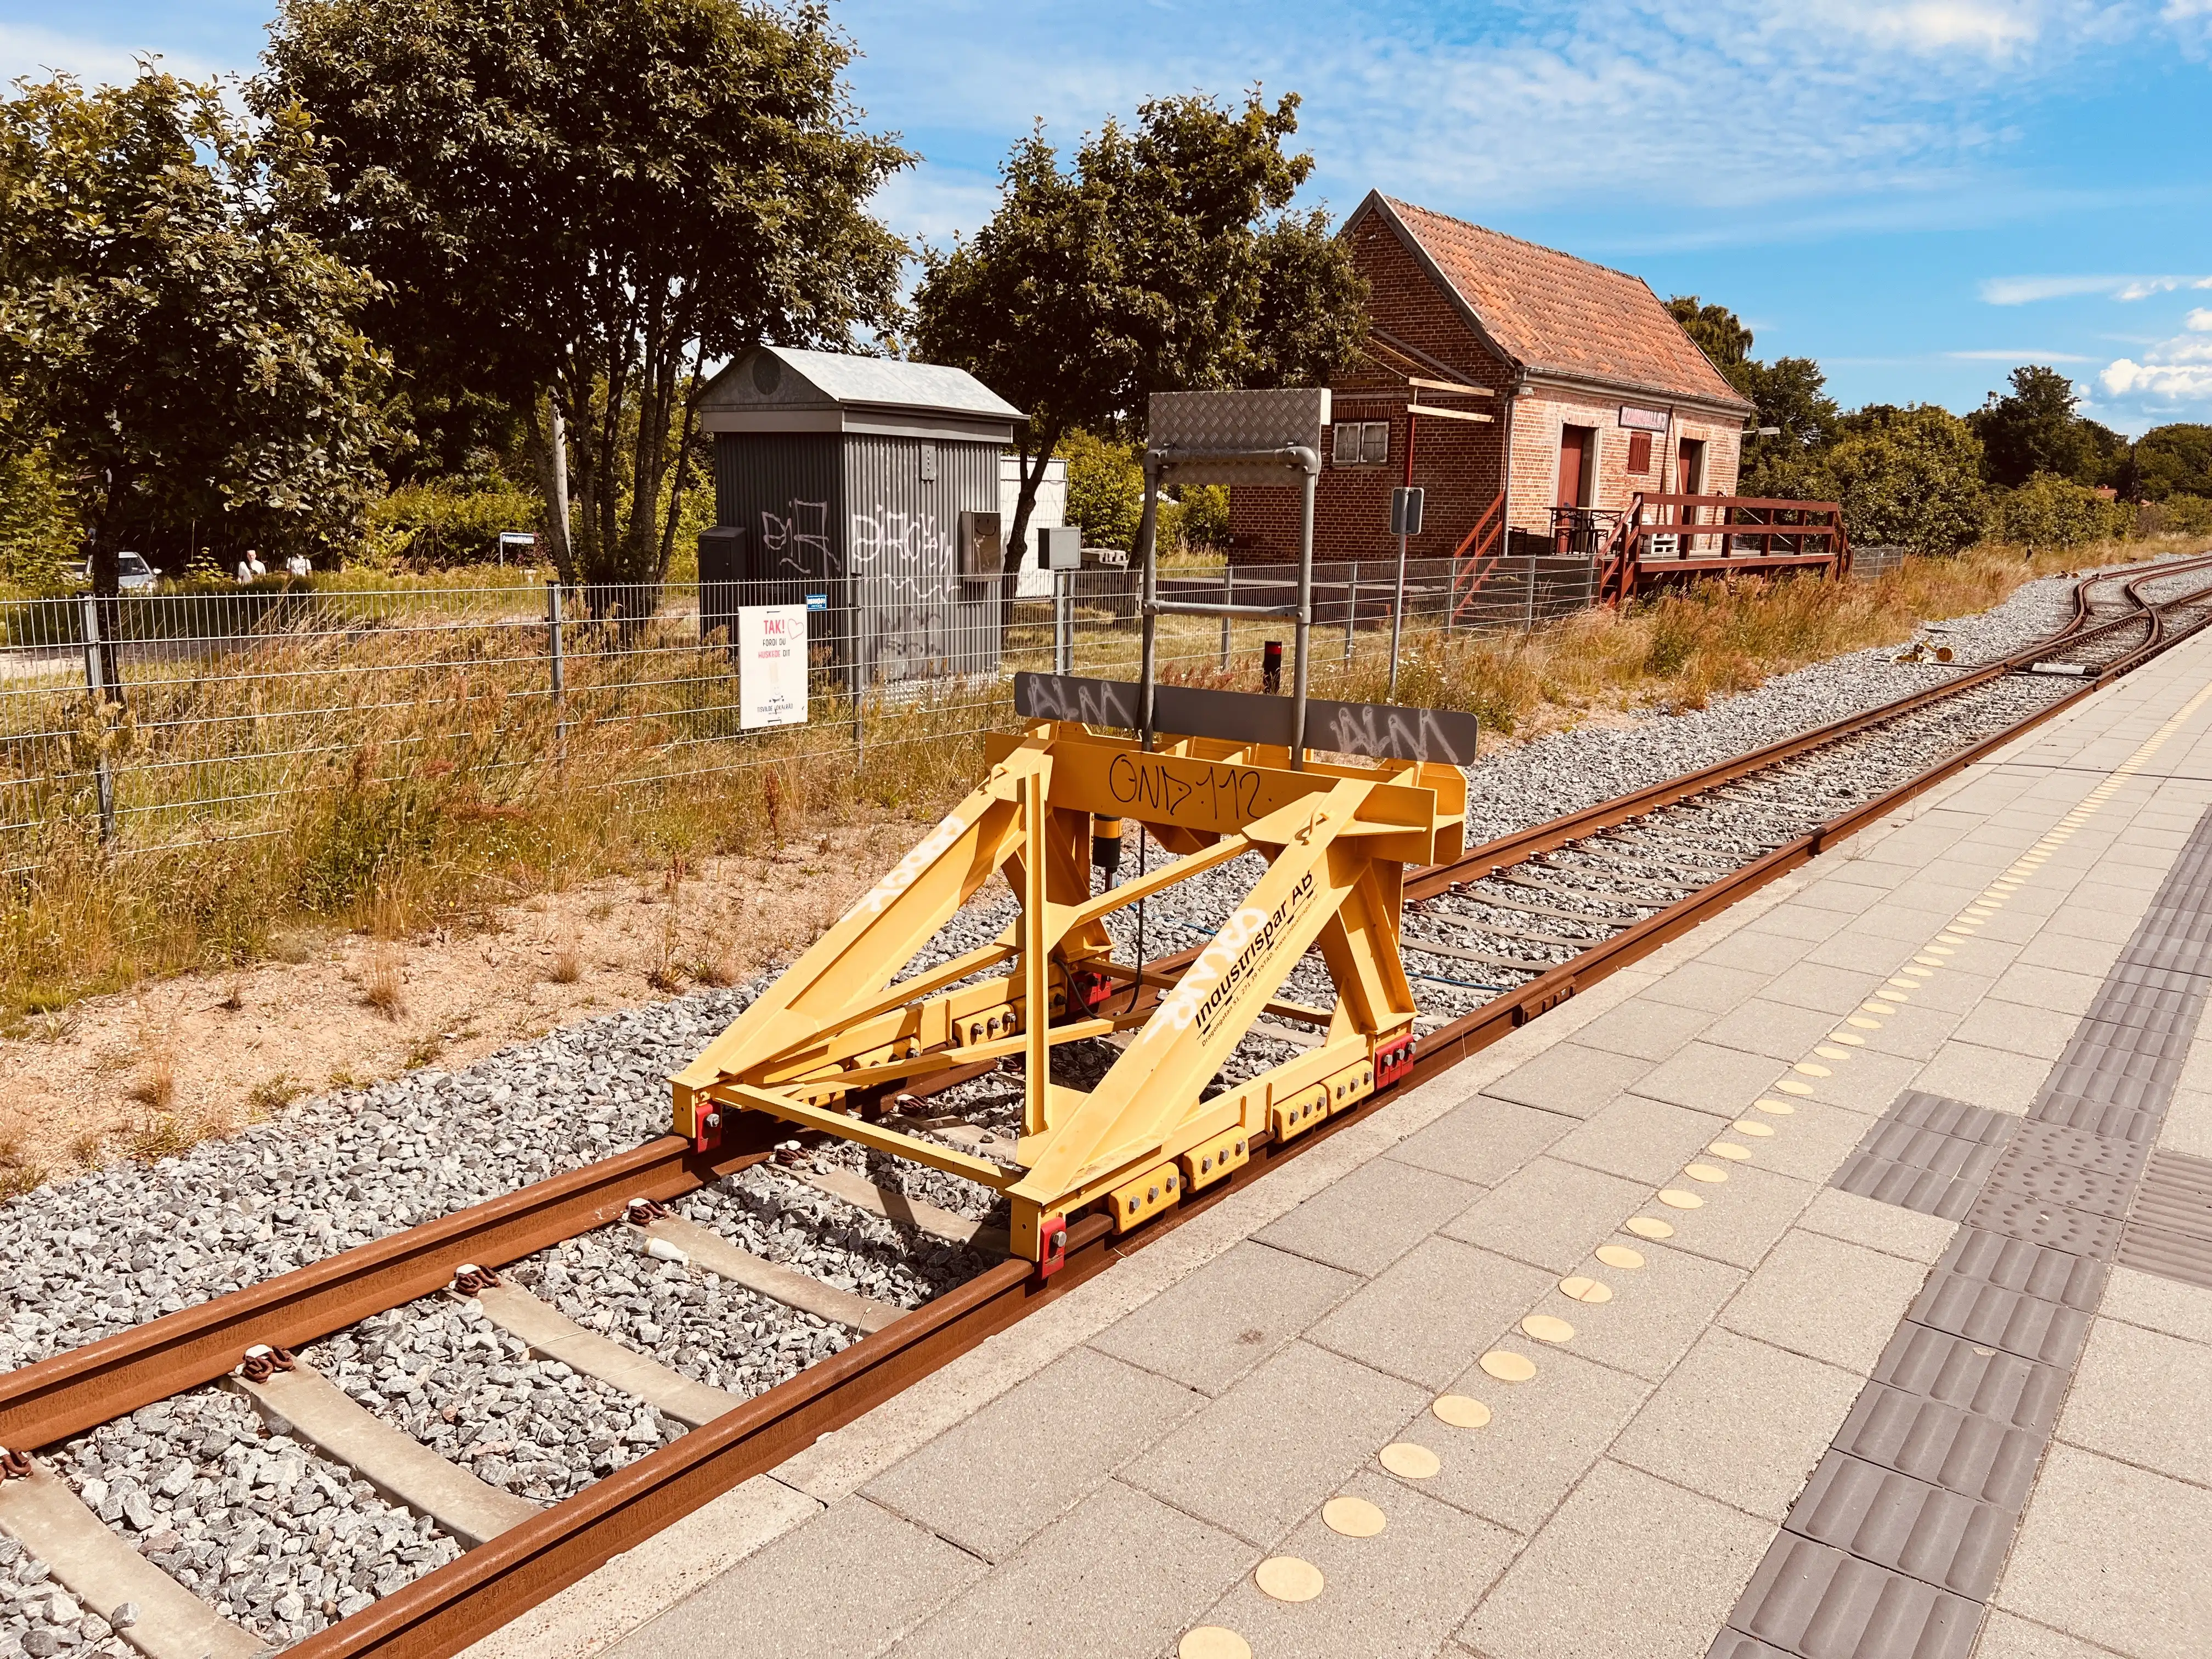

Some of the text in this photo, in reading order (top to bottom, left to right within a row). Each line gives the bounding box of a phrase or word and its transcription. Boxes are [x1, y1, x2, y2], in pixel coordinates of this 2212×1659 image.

[763, 619, 785, 635] TAK!
[763, 637, 786, 647] FORDI DU
[758, 650, 781, 659] HUSKEDE
[1201, 1006, 1233, 1047] Dragongatan
[1241, 982, 1251, 995] 271
[1251, 972, 1257, 983] 39
